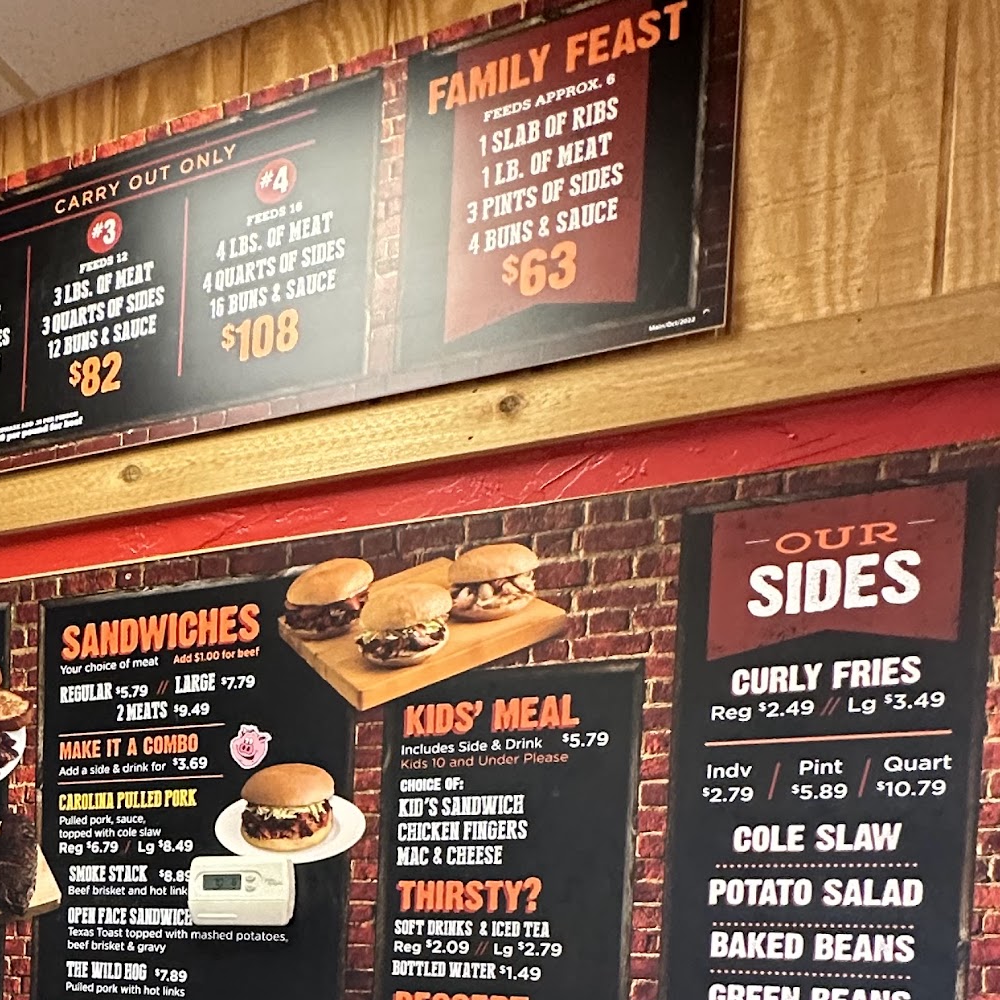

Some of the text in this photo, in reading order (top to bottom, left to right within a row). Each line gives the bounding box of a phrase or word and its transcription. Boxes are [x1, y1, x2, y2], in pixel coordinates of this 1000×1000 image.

[428, 1, 688, 115] FAMILY FEAST
[484, 74, 615, 122] FEEDS APPROX. 6
[479, 97, 619, 156] 1 SLAB OF RIBS
[54, 145, 236, 214] CARRY OUT ONLY
[260, 166, 288, 193] #4
[92, 218, 115, 245] #3
[216, 211, 333, 261] 4 LBS. OF MEAT
[468, 197, 618, 254] 4 BUNS & SAUCE
[502, 240, 577, 296] $63
[222, 309, 299, 362] $108
[69, 352, 122, 396] $82
[776, 522, 897, 554] OUR
[748, 550, 921, 617] SIDES
[61, 603, 260, 661] SANDWICHES
[60, 656, 158, 675] Your choice of meat
[731, 656, 922, 696] CURLY FRIES
[60, 673, 255, 703] REGULAR $5.79 LARGE $7.79
[711, 692, 945, 722] Reg $2.49 Lg $3.49
[403, 694, 579, 738] KIDS' MEAL
[59, 734, 199, 761] MAKE IT A COMBO
[706, 755, 952, 779] Indv Pint Quart
[397, 820, 528, 841] CHICKEN FINGERS
[733, 823, 902, 853] COLE SLAW
[396, 876, 542, 914] THIRSTY?
[708, 879, 923, 907] POTATO SALAD
[710, 931, 915, 963] BAKED BEANS
[66, 961, 187, 982] THE WILD HOG $7.89
